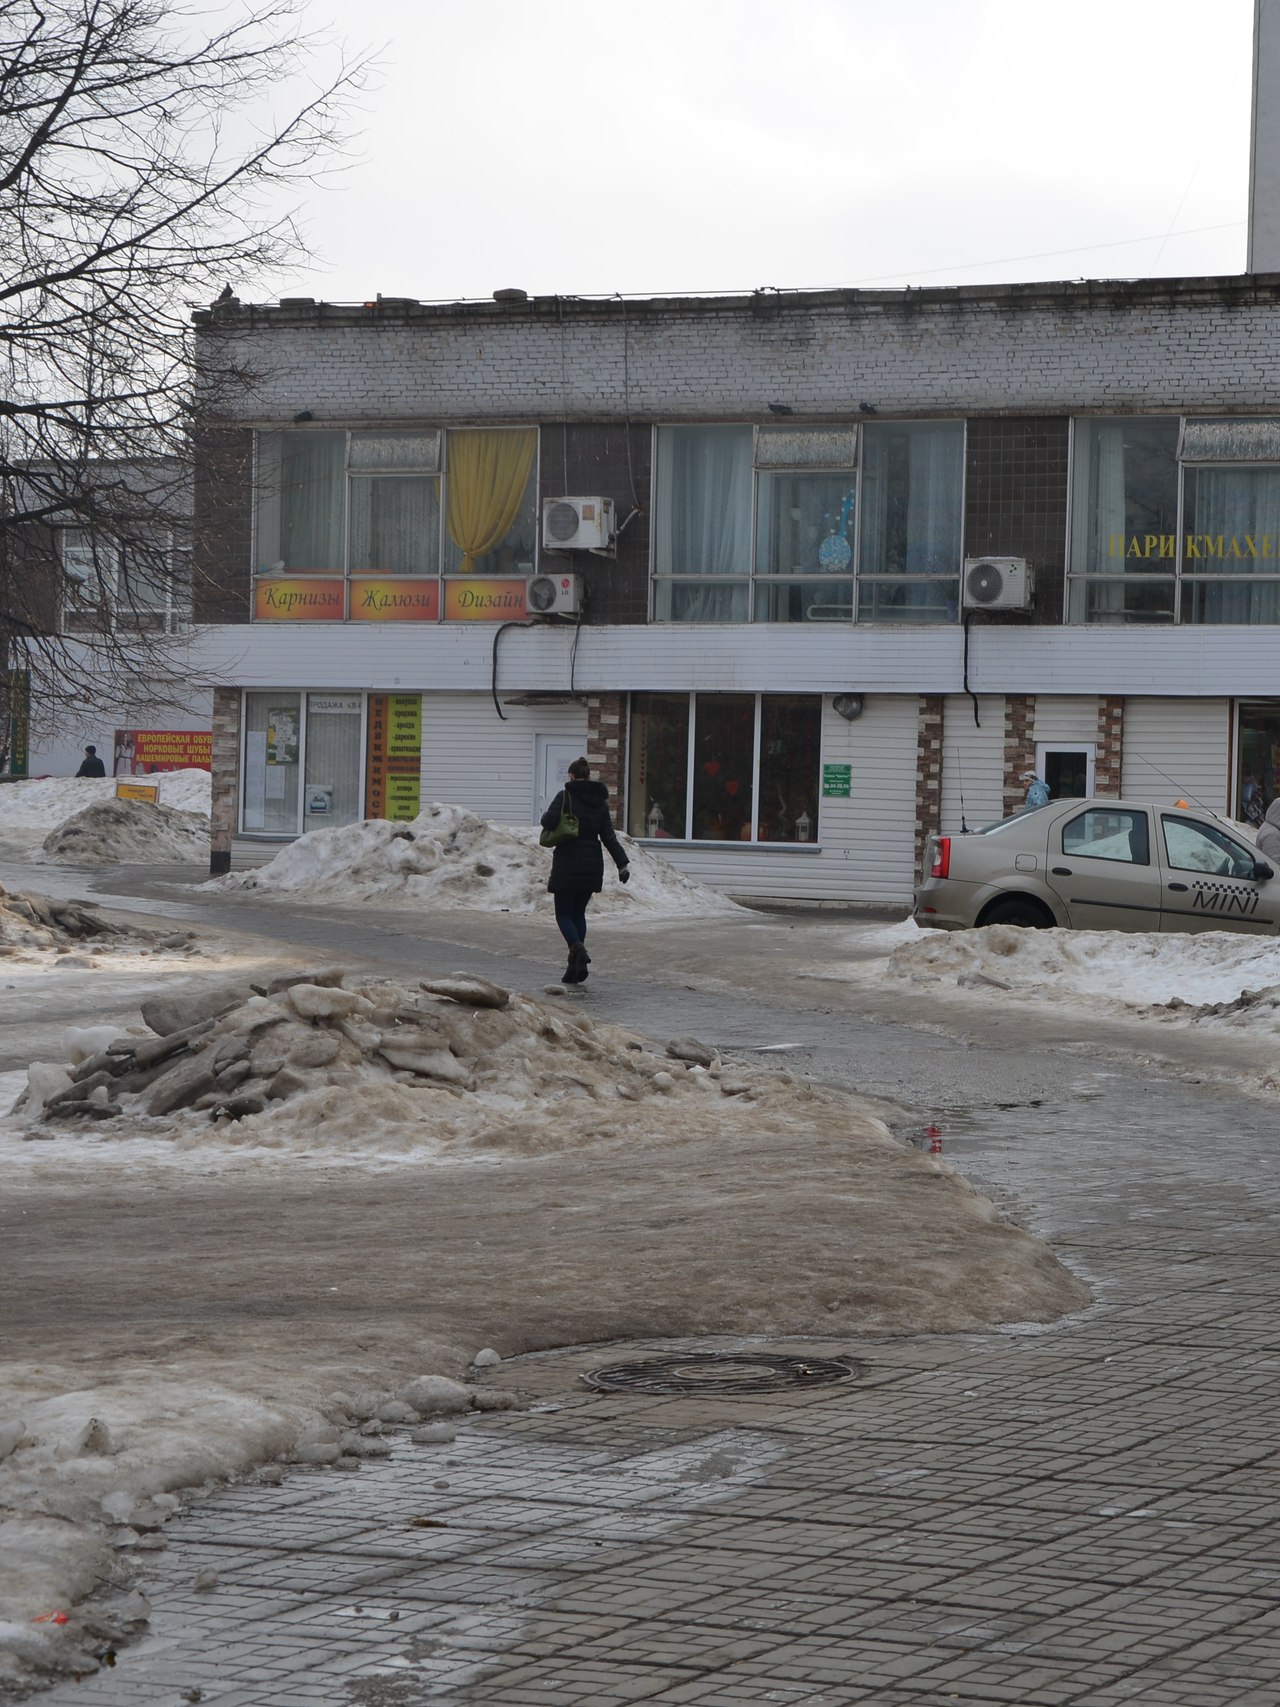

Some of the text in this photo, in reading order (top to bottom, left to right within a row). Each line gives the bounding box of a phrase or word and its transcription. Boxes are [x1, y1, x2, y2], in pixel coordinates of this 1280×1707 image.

[264, 588, 339, 611] Карнизы
[361, 590, 431, 608] Жалюзи
[458, 590, 524, 608] Дизайн
[138, 733, 212, 744] ЕВРОПЕЙСКАЯ ОБУВ
[136, 754, 212, 763] КАШЕМИРОВЫЕ ПАЛЬТ
[144, 745, 211, 754] НОРКОВЫЕ ШУБЫ
[371, 697, 382, 819] НЕДВИЖИМОСТ
[1192, 890, 1259, 914] MINI
